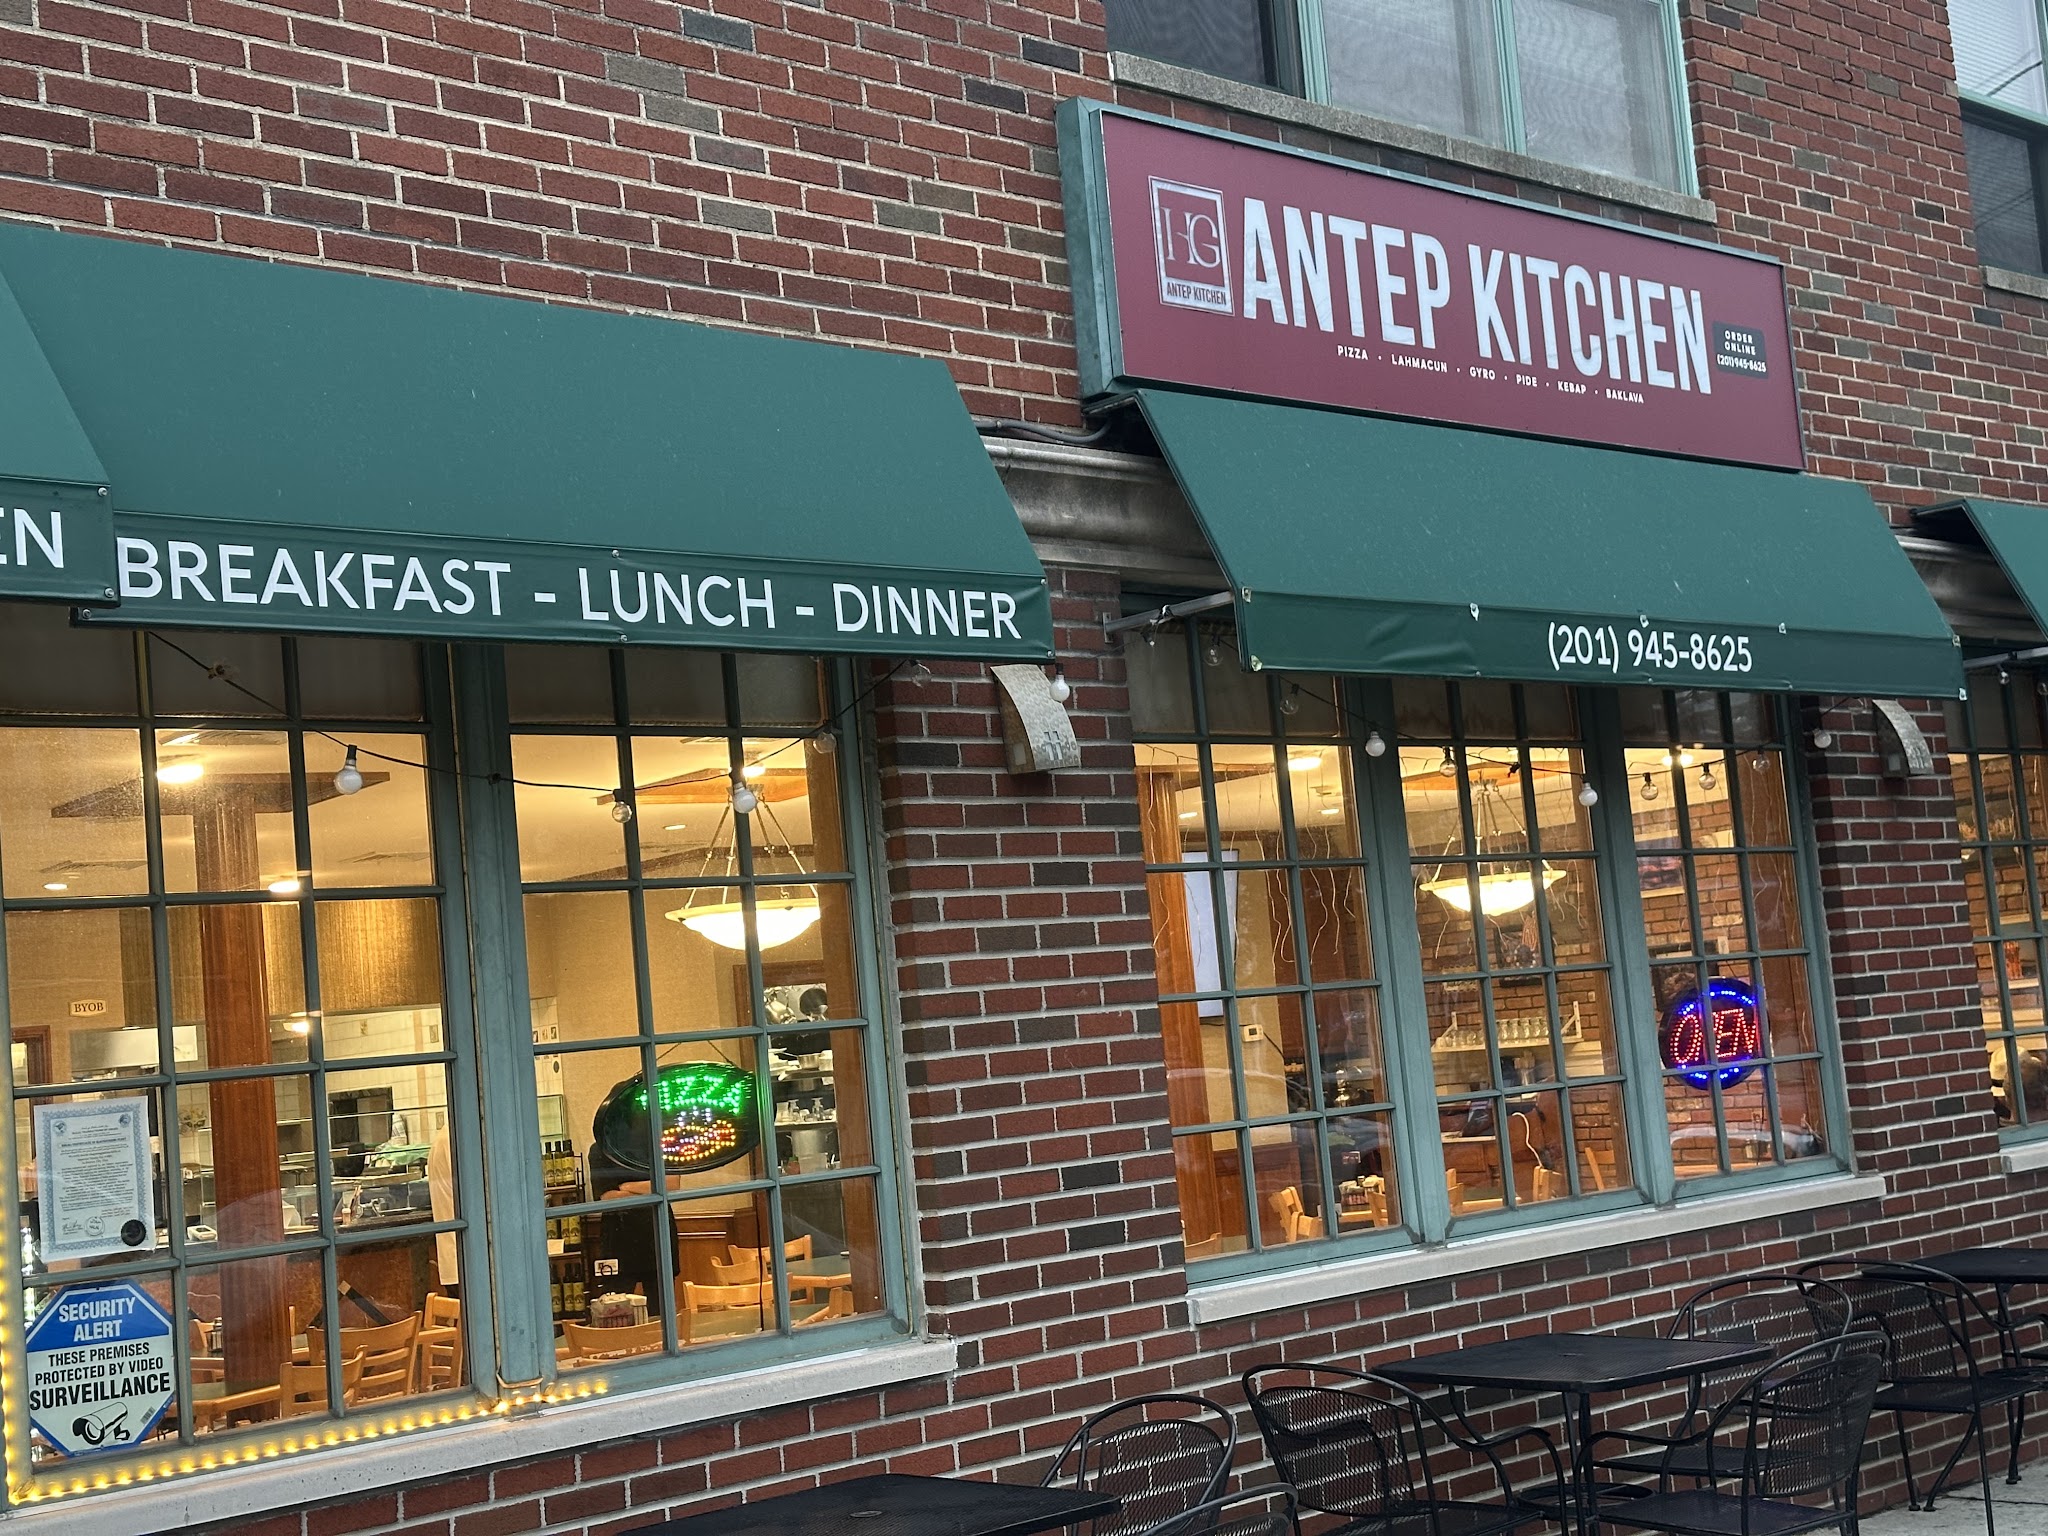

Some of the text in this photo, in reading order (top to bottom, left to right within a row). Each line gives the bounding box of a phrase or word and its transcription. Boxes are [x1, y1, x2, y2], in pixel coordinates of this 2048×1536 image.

[1160, 206, 1221, 268] HG
[1166, 282, 1227, 305] ANTEP KITCHEN
[1243, 197, 1712, 394] ANTEP KITCHEN
[1724, 330, 1753, 344] ORDER
[1724, 341, 1756, 355] ONLINE
[1337, 345, 1644, 404] PIZZA LAHMACUN GYRO PIDE KEBAP BAKLAVA
[117, 537, 511, 616] BREAKFAST
[578, 567, 775, 629] LUNCH
[832, 583, 1021, 639] DINNER
[1548, 621, 1752, 673] (201) 945-8625
[74, 1002, 104, 1013] BYOB
[1670, 1008, 1757, 1063] OEN
[58, 1296, 136, 1323] SECURITY
[73, 1319, 123, 1342] ALERT
[48, 1342, 150, 1367] THESE PREMISES
[35, 1356, 163, 1385] PROTECTED BY VIDEO
[29, 1372, 171, 1411] SURVEILLANCE
